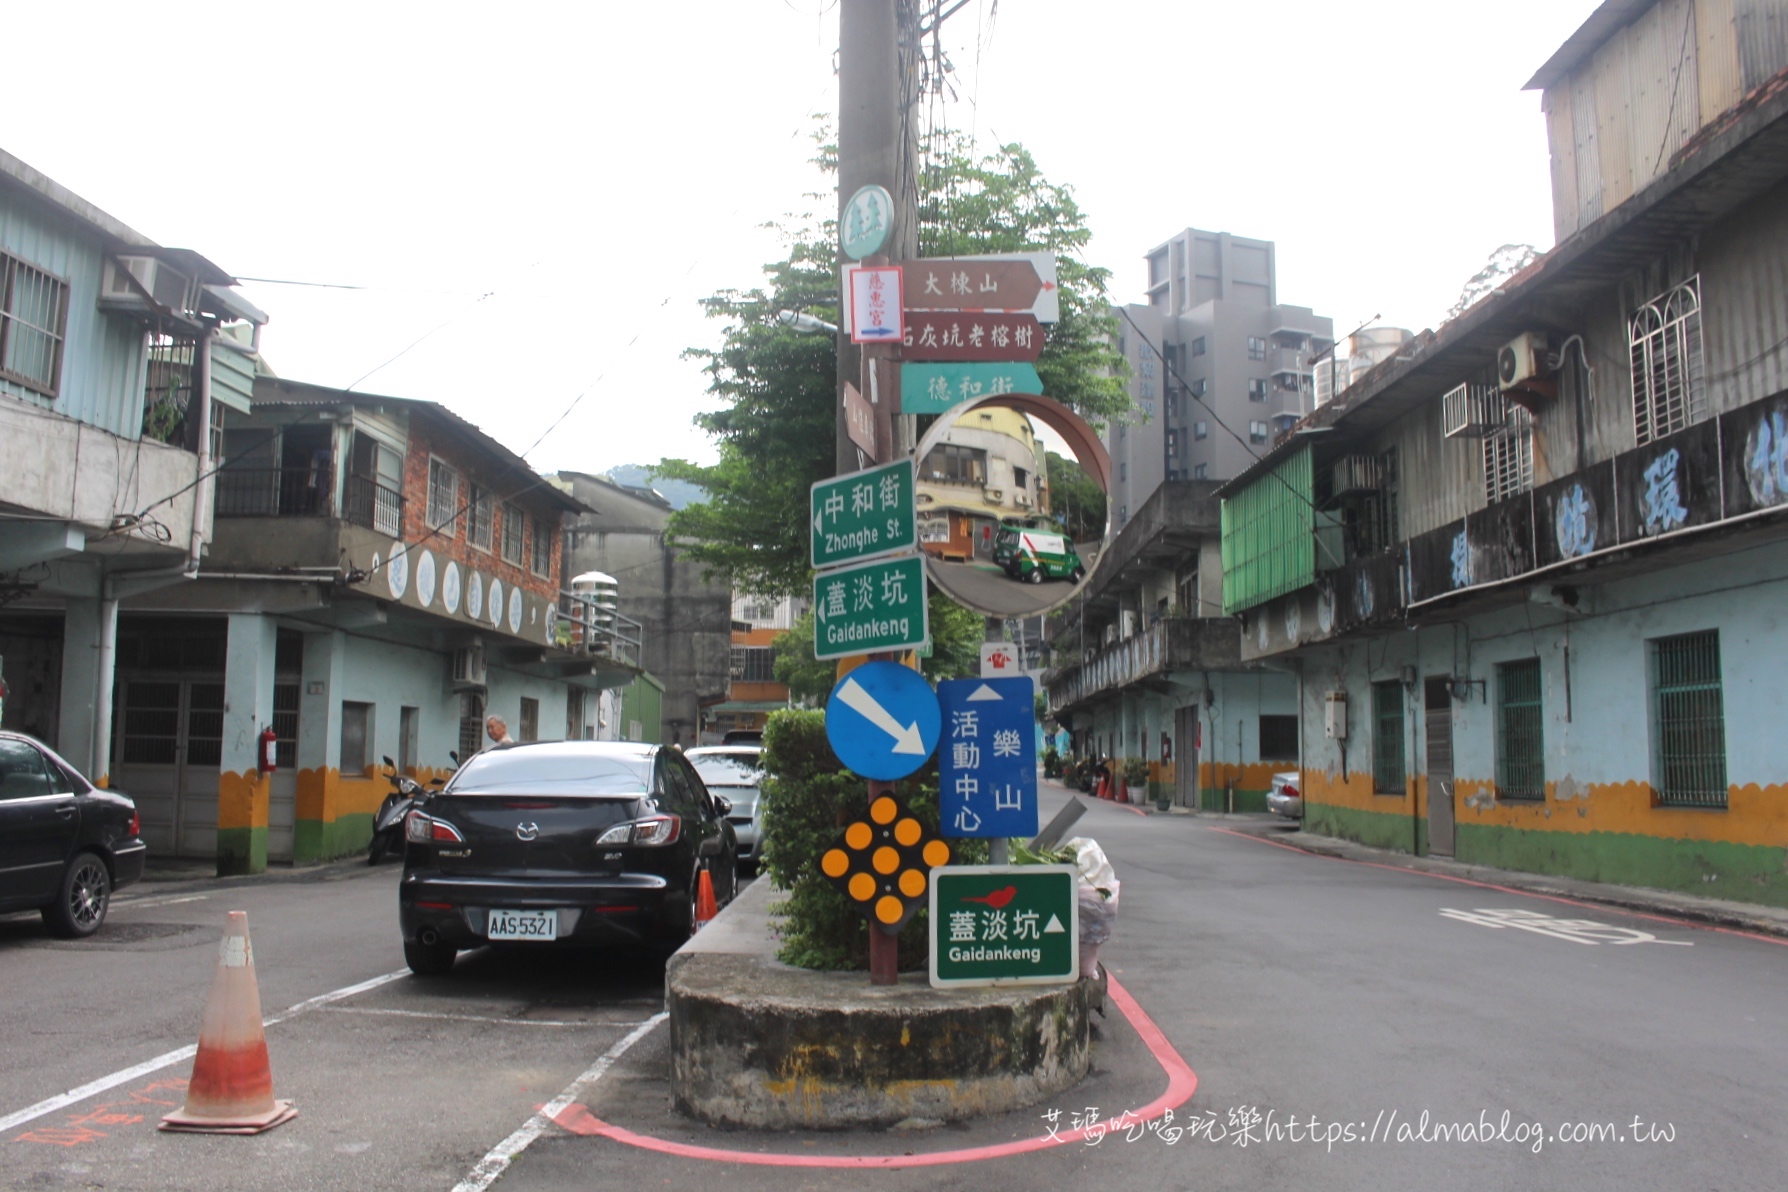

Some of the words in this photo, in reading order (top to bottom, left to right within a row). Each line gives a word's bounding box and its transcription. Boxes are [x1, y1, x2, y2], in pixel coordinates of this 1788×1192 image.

[825, 473, 900, 525] 中和街
[825, 526, 879, 554] Zhonghe
[886, 517, 903, 540] St.
[827, 569, 908, 618] 蓋淡坑
[827, 616, 910, 645] Gaidankeng
[951, 709, 982, 832] 活動中心
[993, 729, 1022, 812] 樂山
[949, 908, 1041, 942] 蓋淡坑
[948, 944, 1042, 964] Gaidankeng
